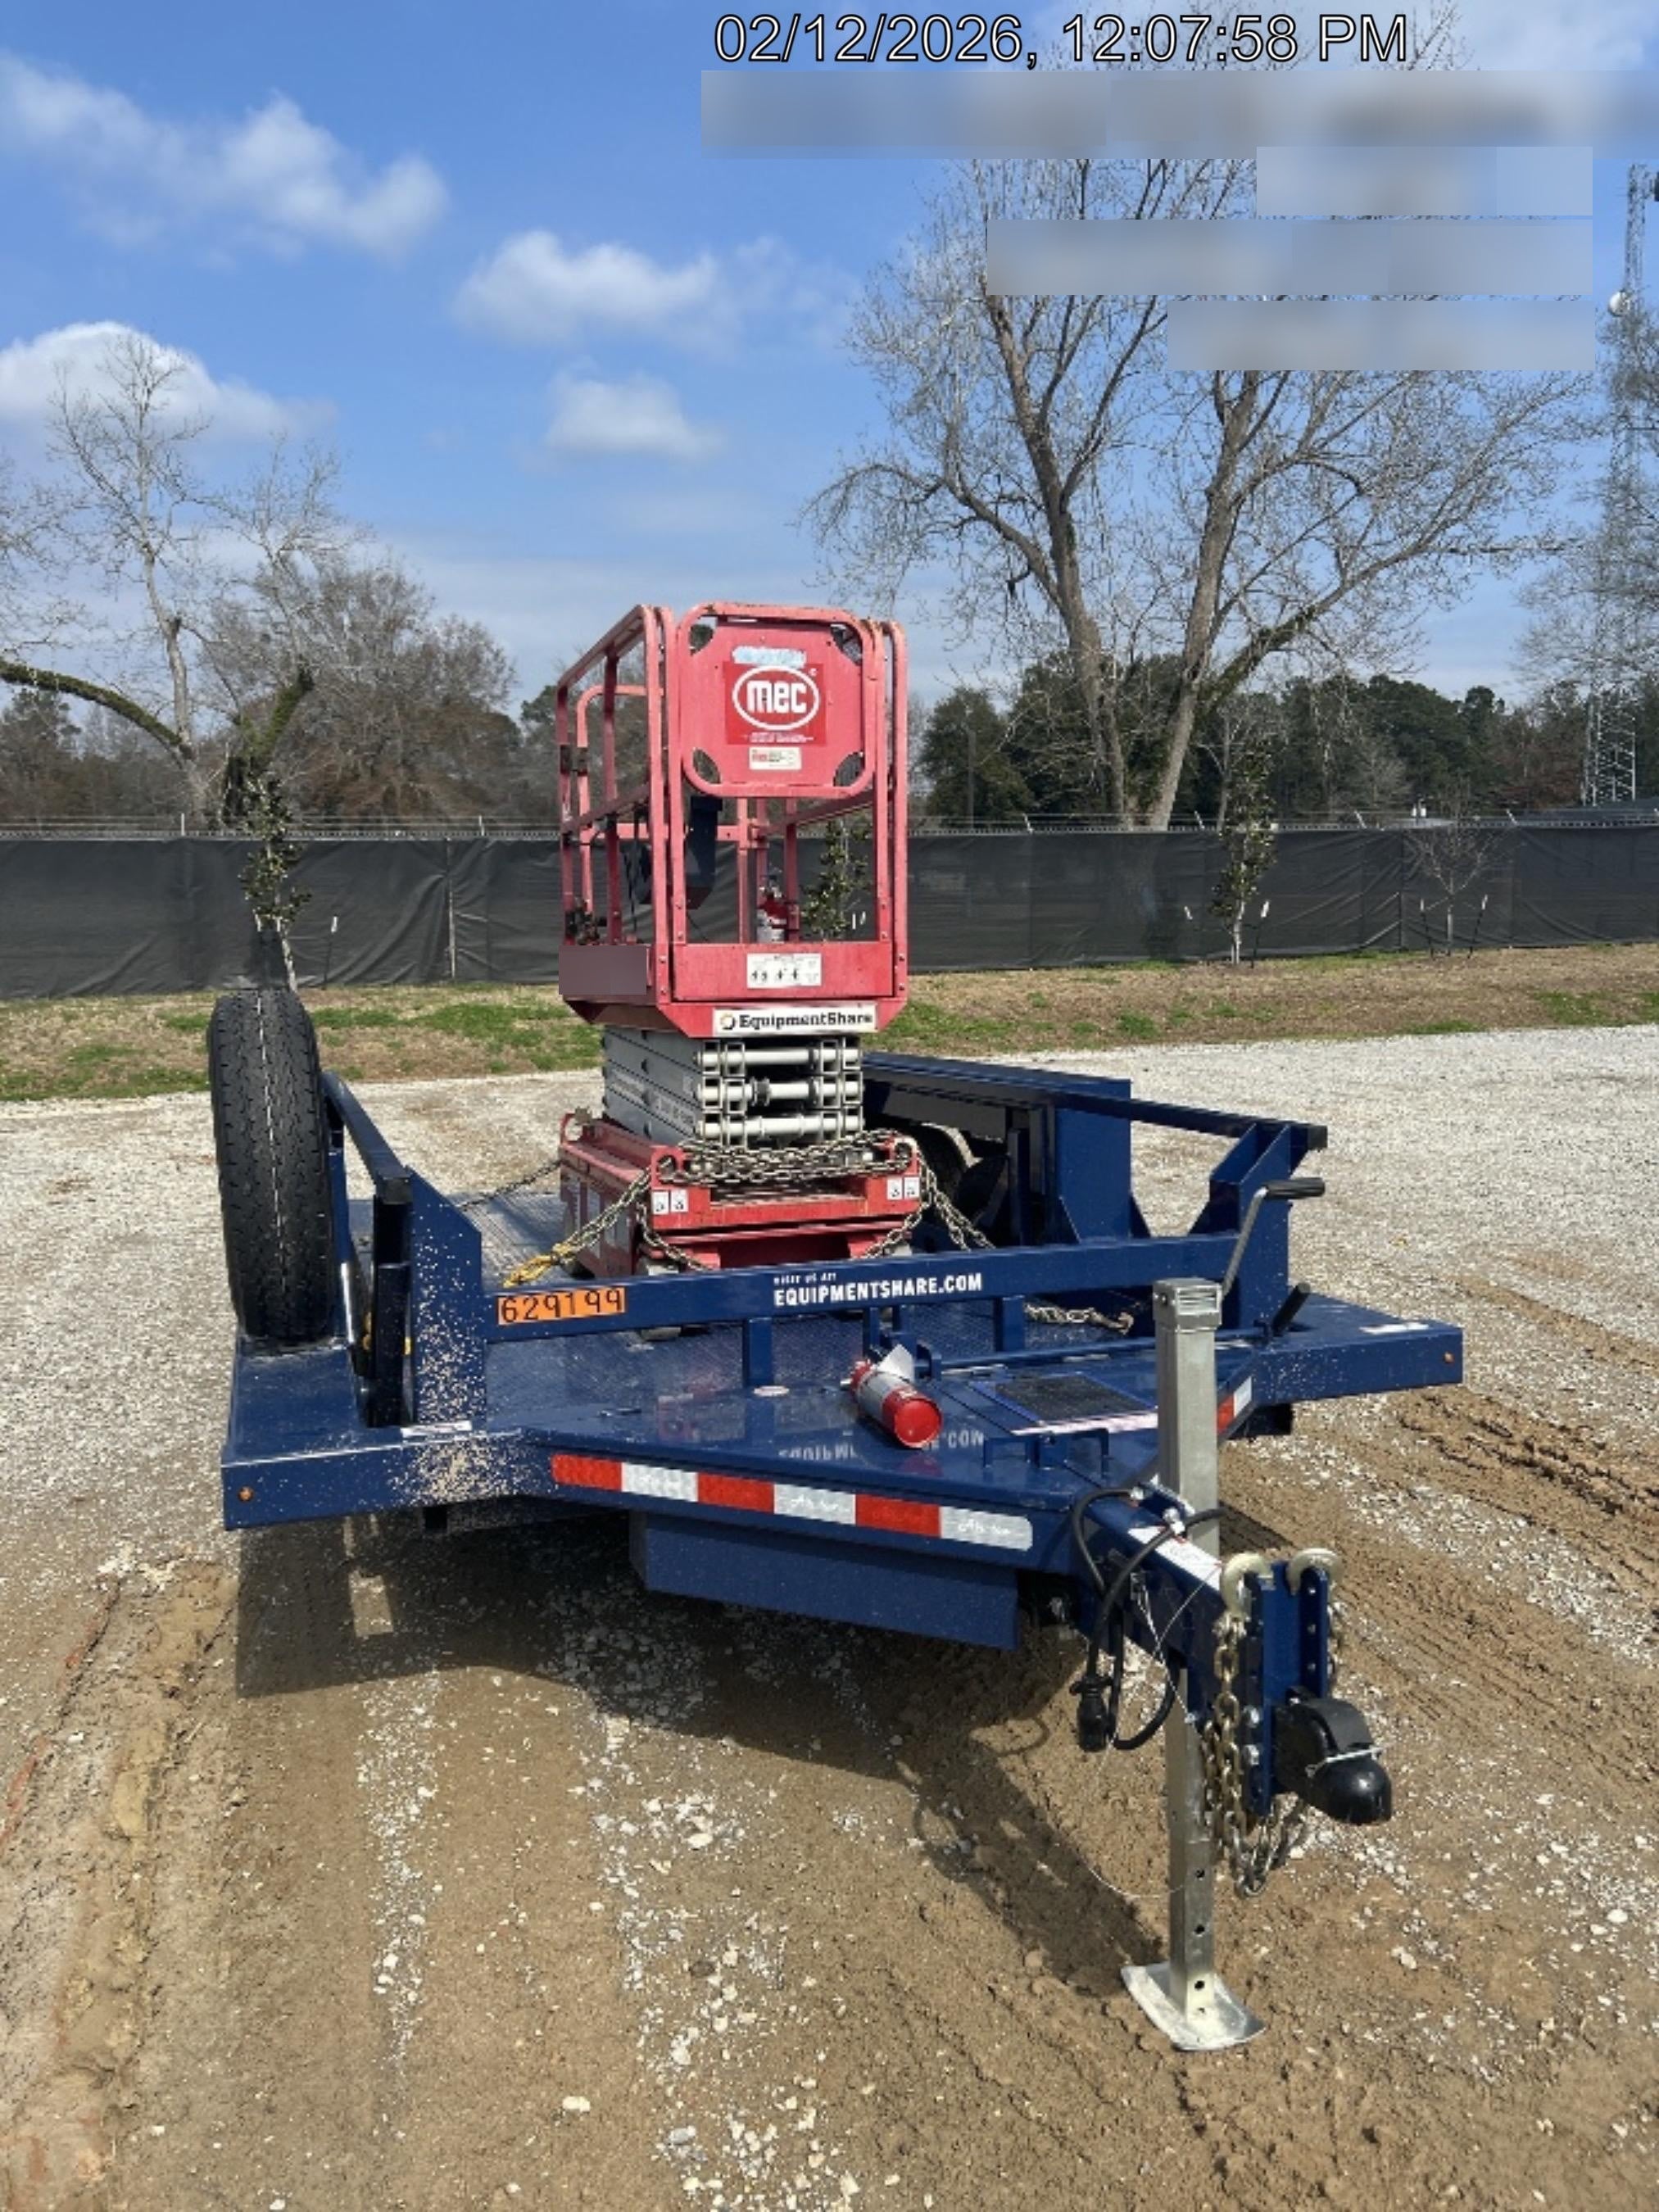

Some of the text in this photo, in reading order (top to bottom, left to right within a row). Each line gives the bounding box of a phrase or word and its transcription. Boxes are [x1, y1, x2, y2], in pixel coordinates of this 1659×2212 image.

[739, 1011, 873, 1030] EquipmentShare
[774, 1272, 982, 1306] EQUIPMENTSHARE.COM
[501, 1290, 622, 1323] 629199
